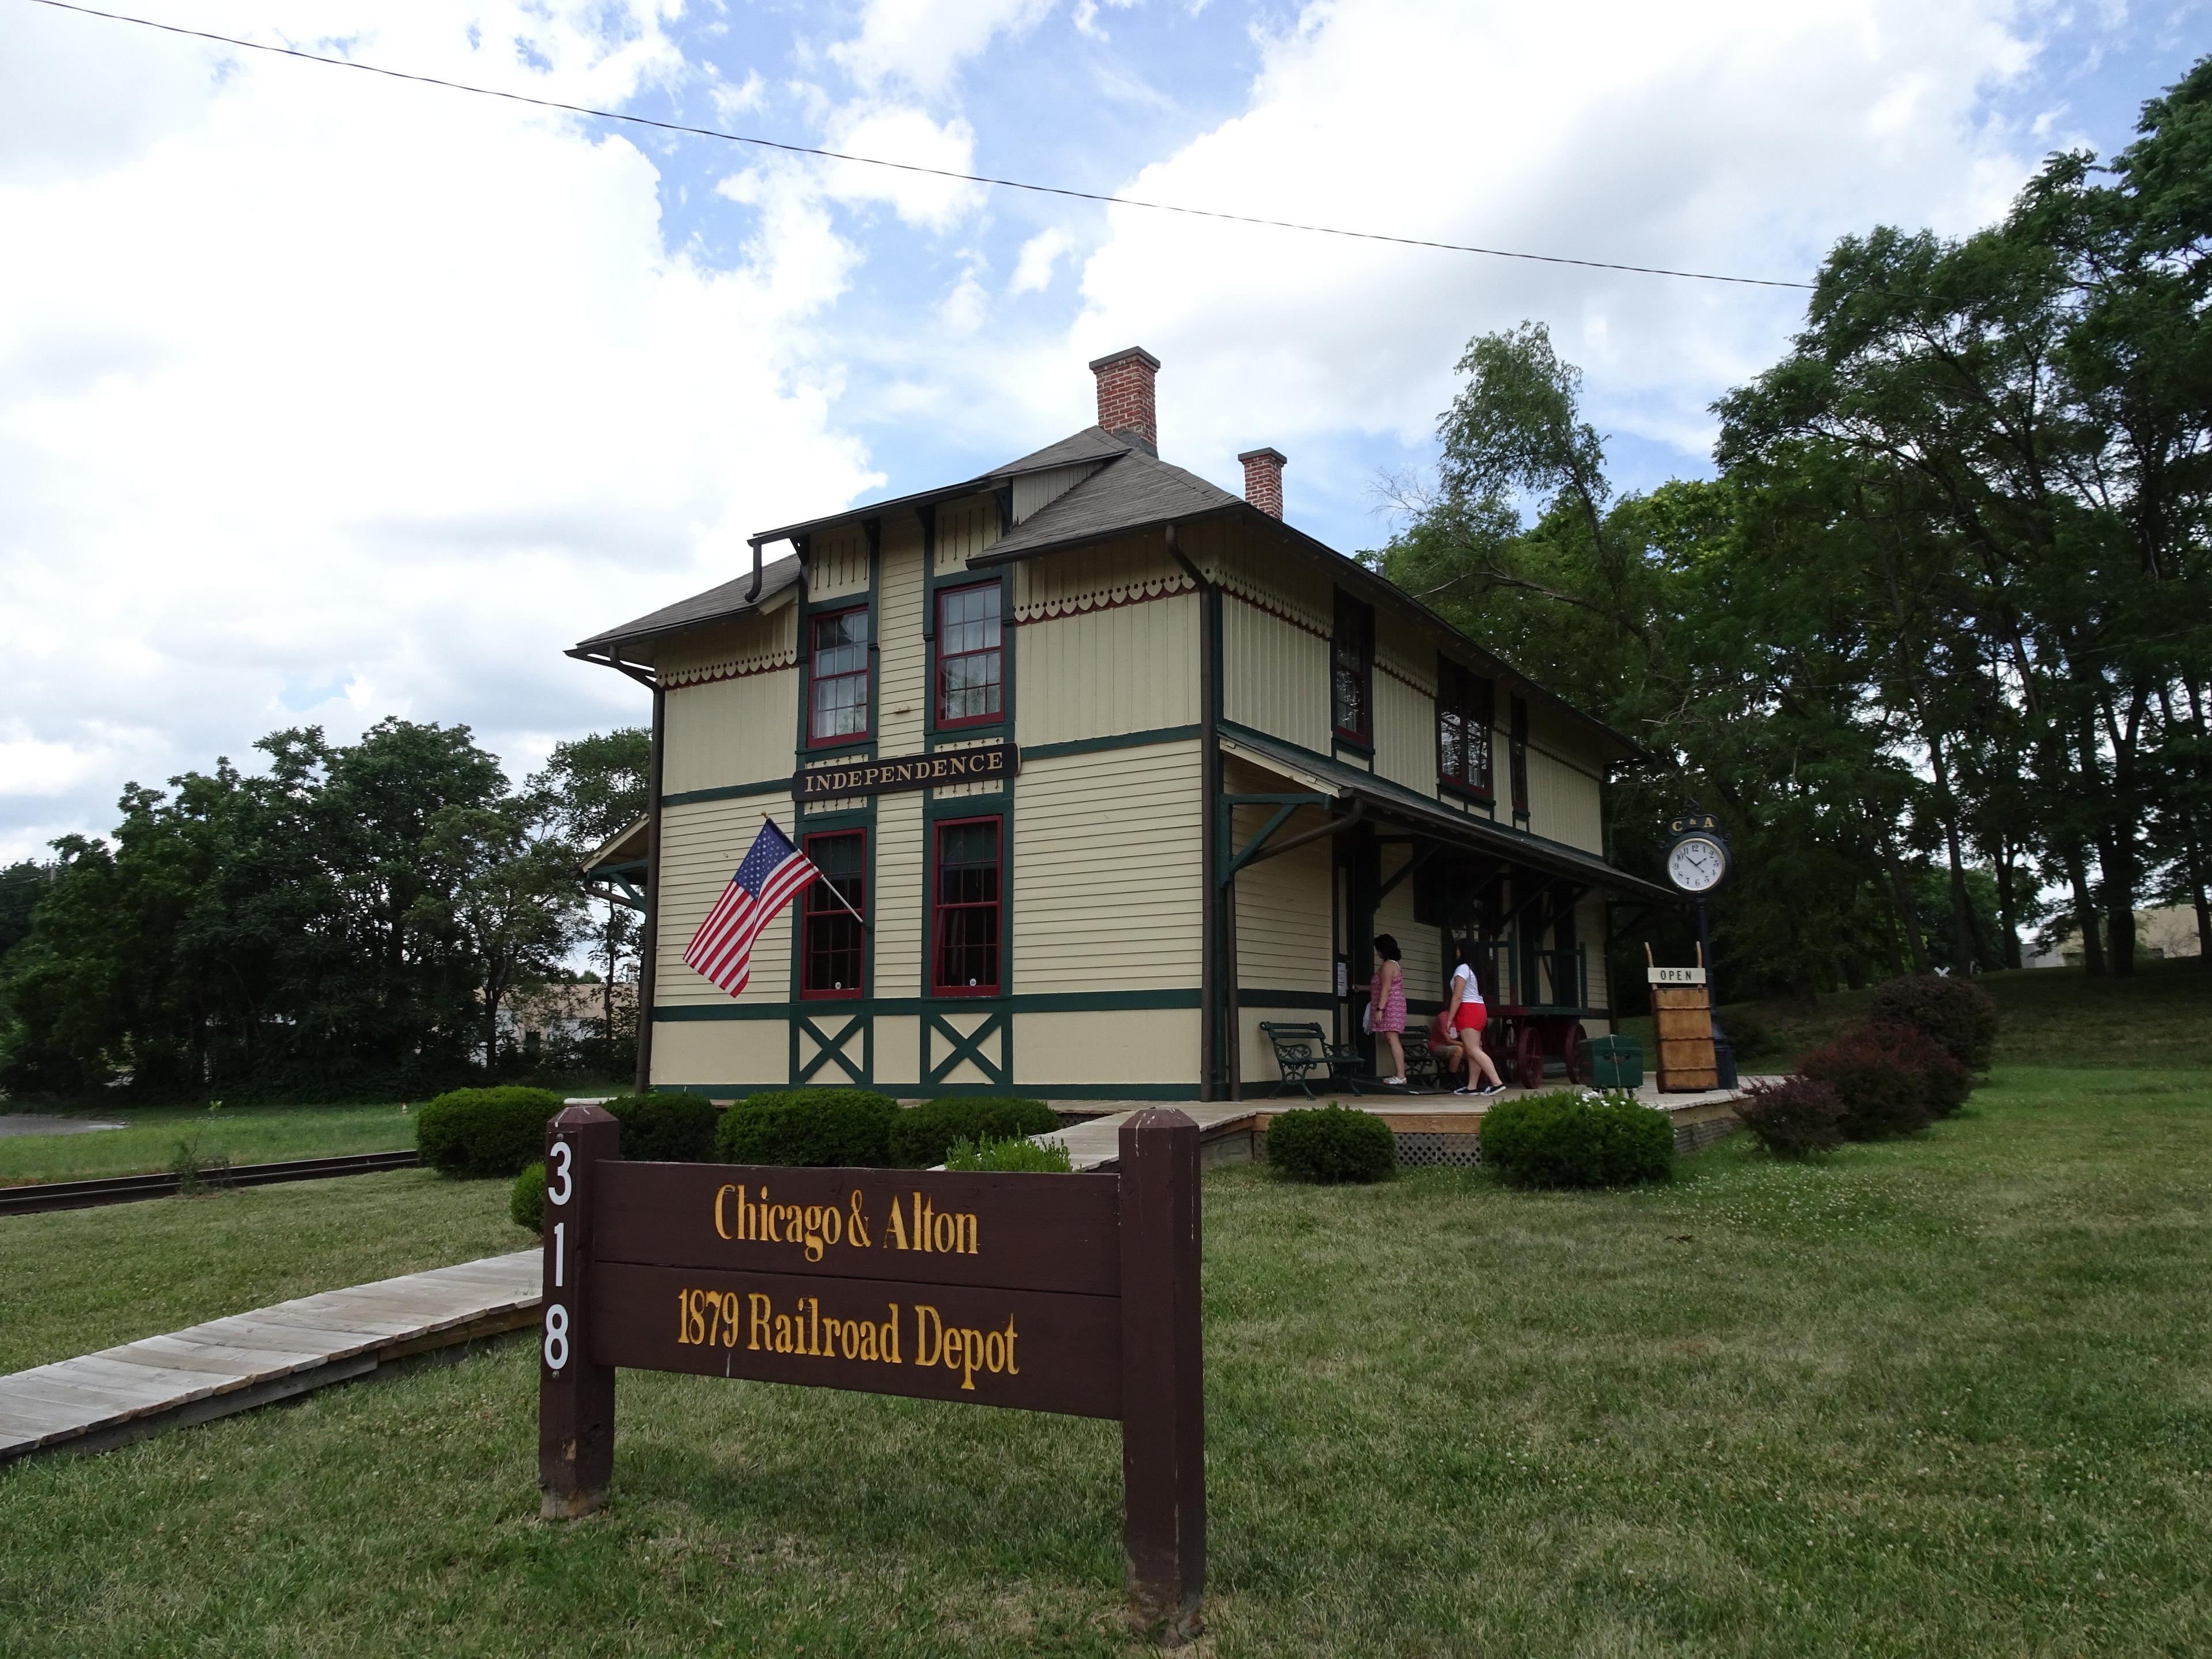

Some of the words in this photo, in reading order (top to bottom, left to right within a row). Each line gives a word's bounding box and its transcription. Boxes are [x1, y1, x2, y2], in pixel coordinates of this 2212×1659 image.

[805, 752, 1003, 793] INDEPENDENCE
[1672, 821, 1683, 831] C
[1703, 817, 1715, 828] A
[1661, 970, 1691, 980] OPEN
[714, 1184, 842, 1262] Chicago
[847, 1189, 871, 1247] &
[883, 1191, 978, 1254] Alton
[677, 1287, 740, 1348] 1879
[747, 1293, 902, 1364] Railroad
[915, 1304, 1020, 1390] Depot
